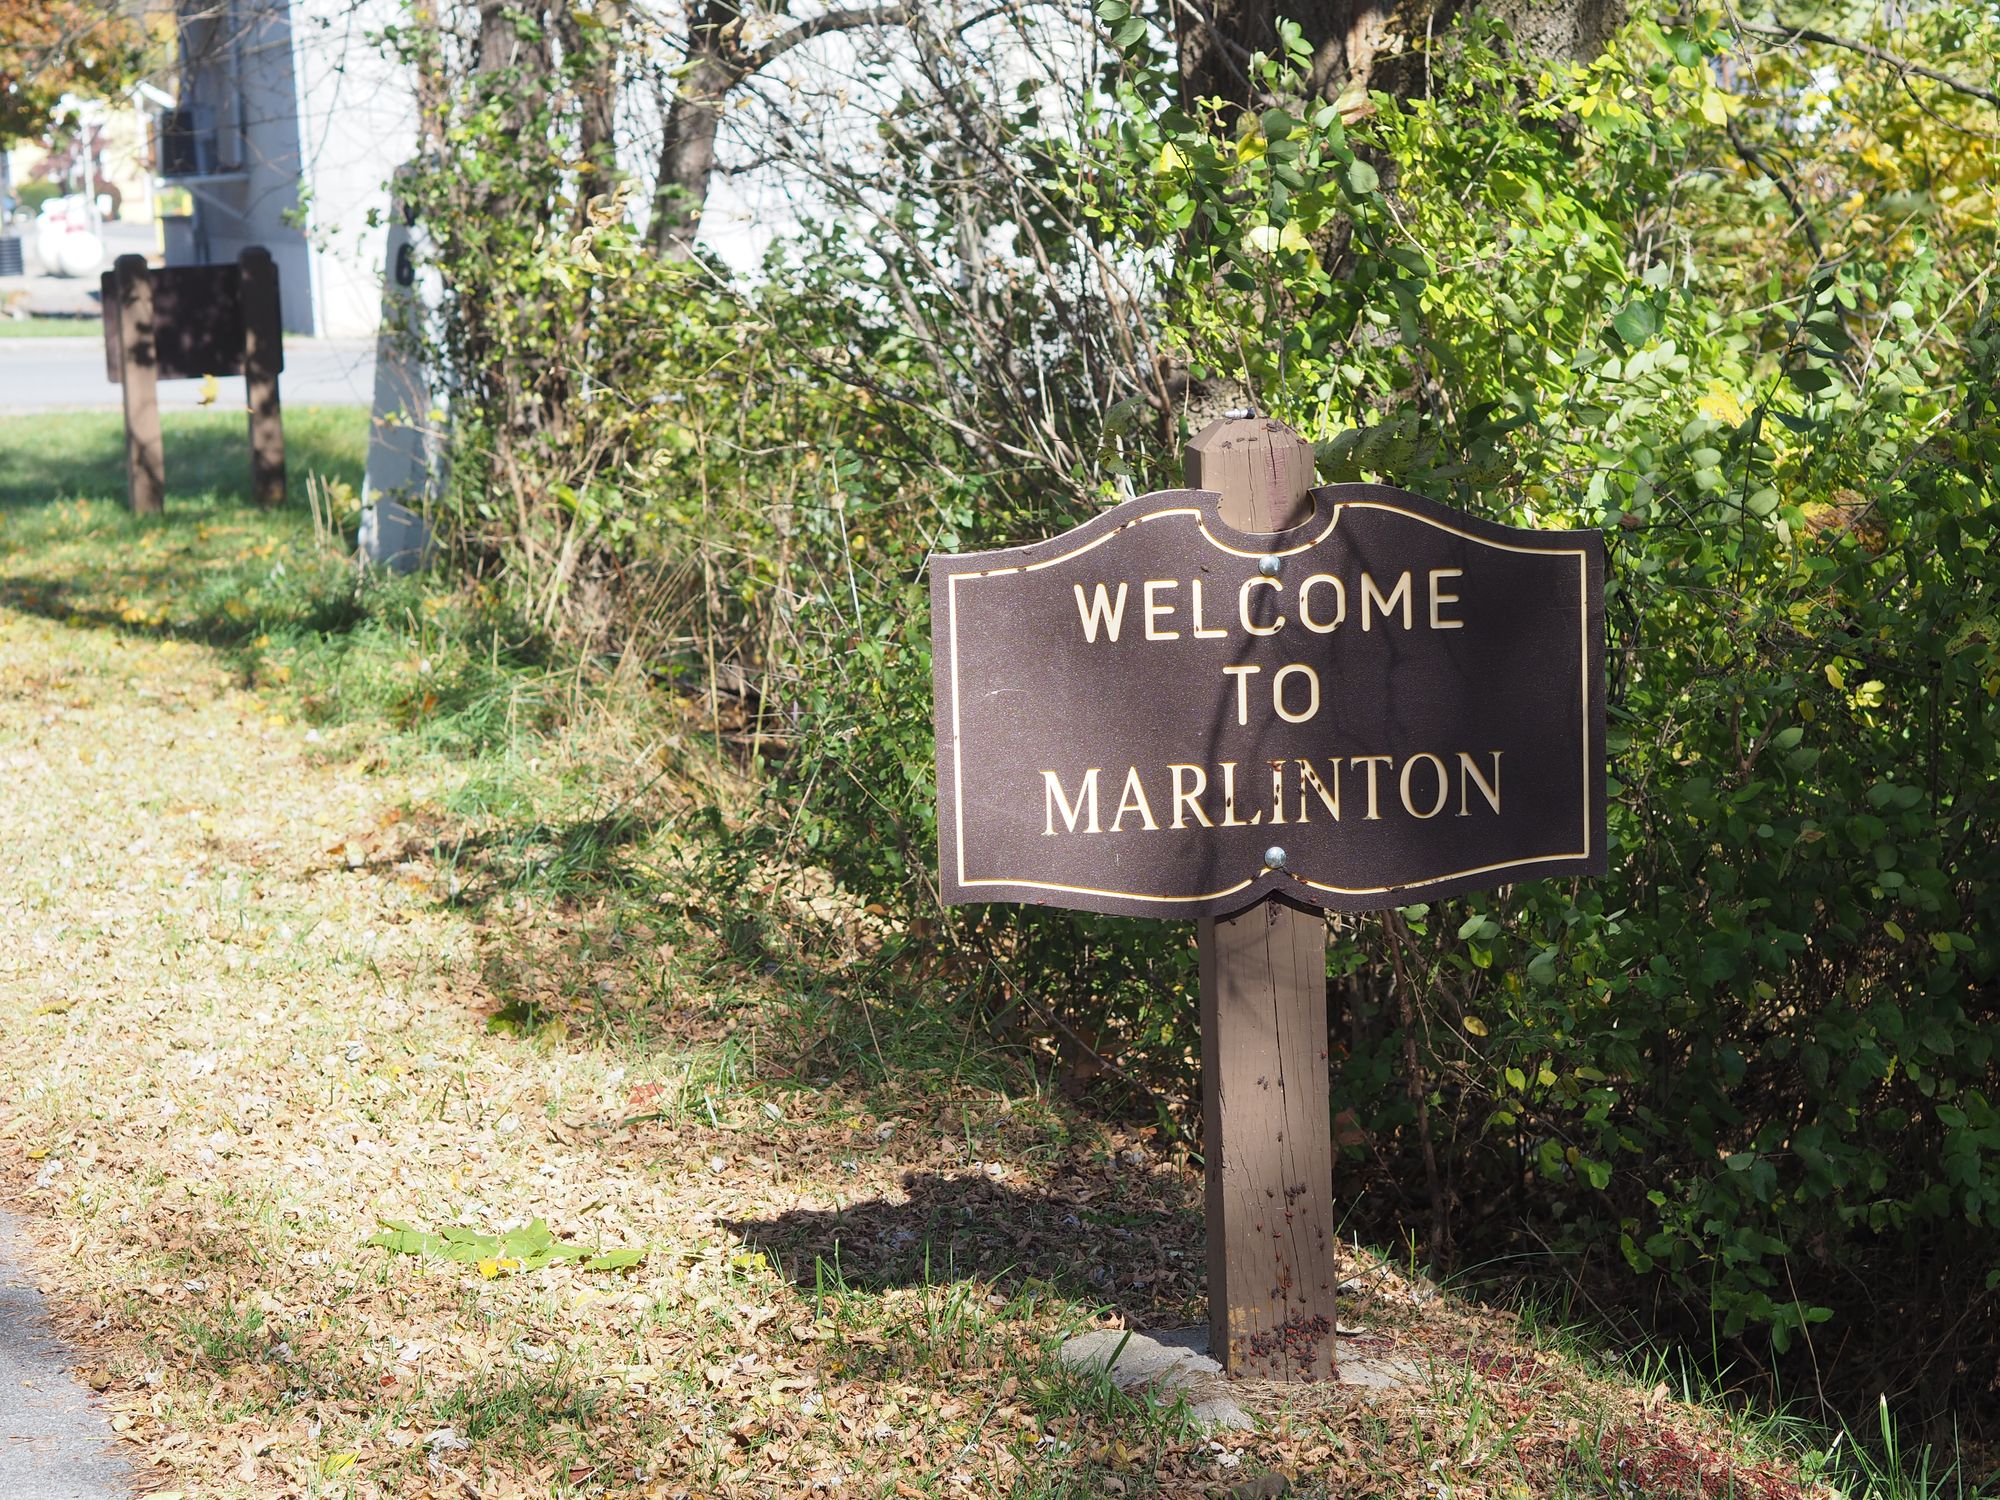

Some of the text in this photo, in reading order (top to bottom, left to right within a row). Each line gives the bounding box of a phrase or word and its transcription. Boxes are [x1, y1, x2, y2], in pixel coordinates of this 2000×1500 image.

[1073, 568, 1464, 643] WELCOME
[1222, 664, 1321, 725] TO
[1040, 750, 1504, 837] MARLINTON
